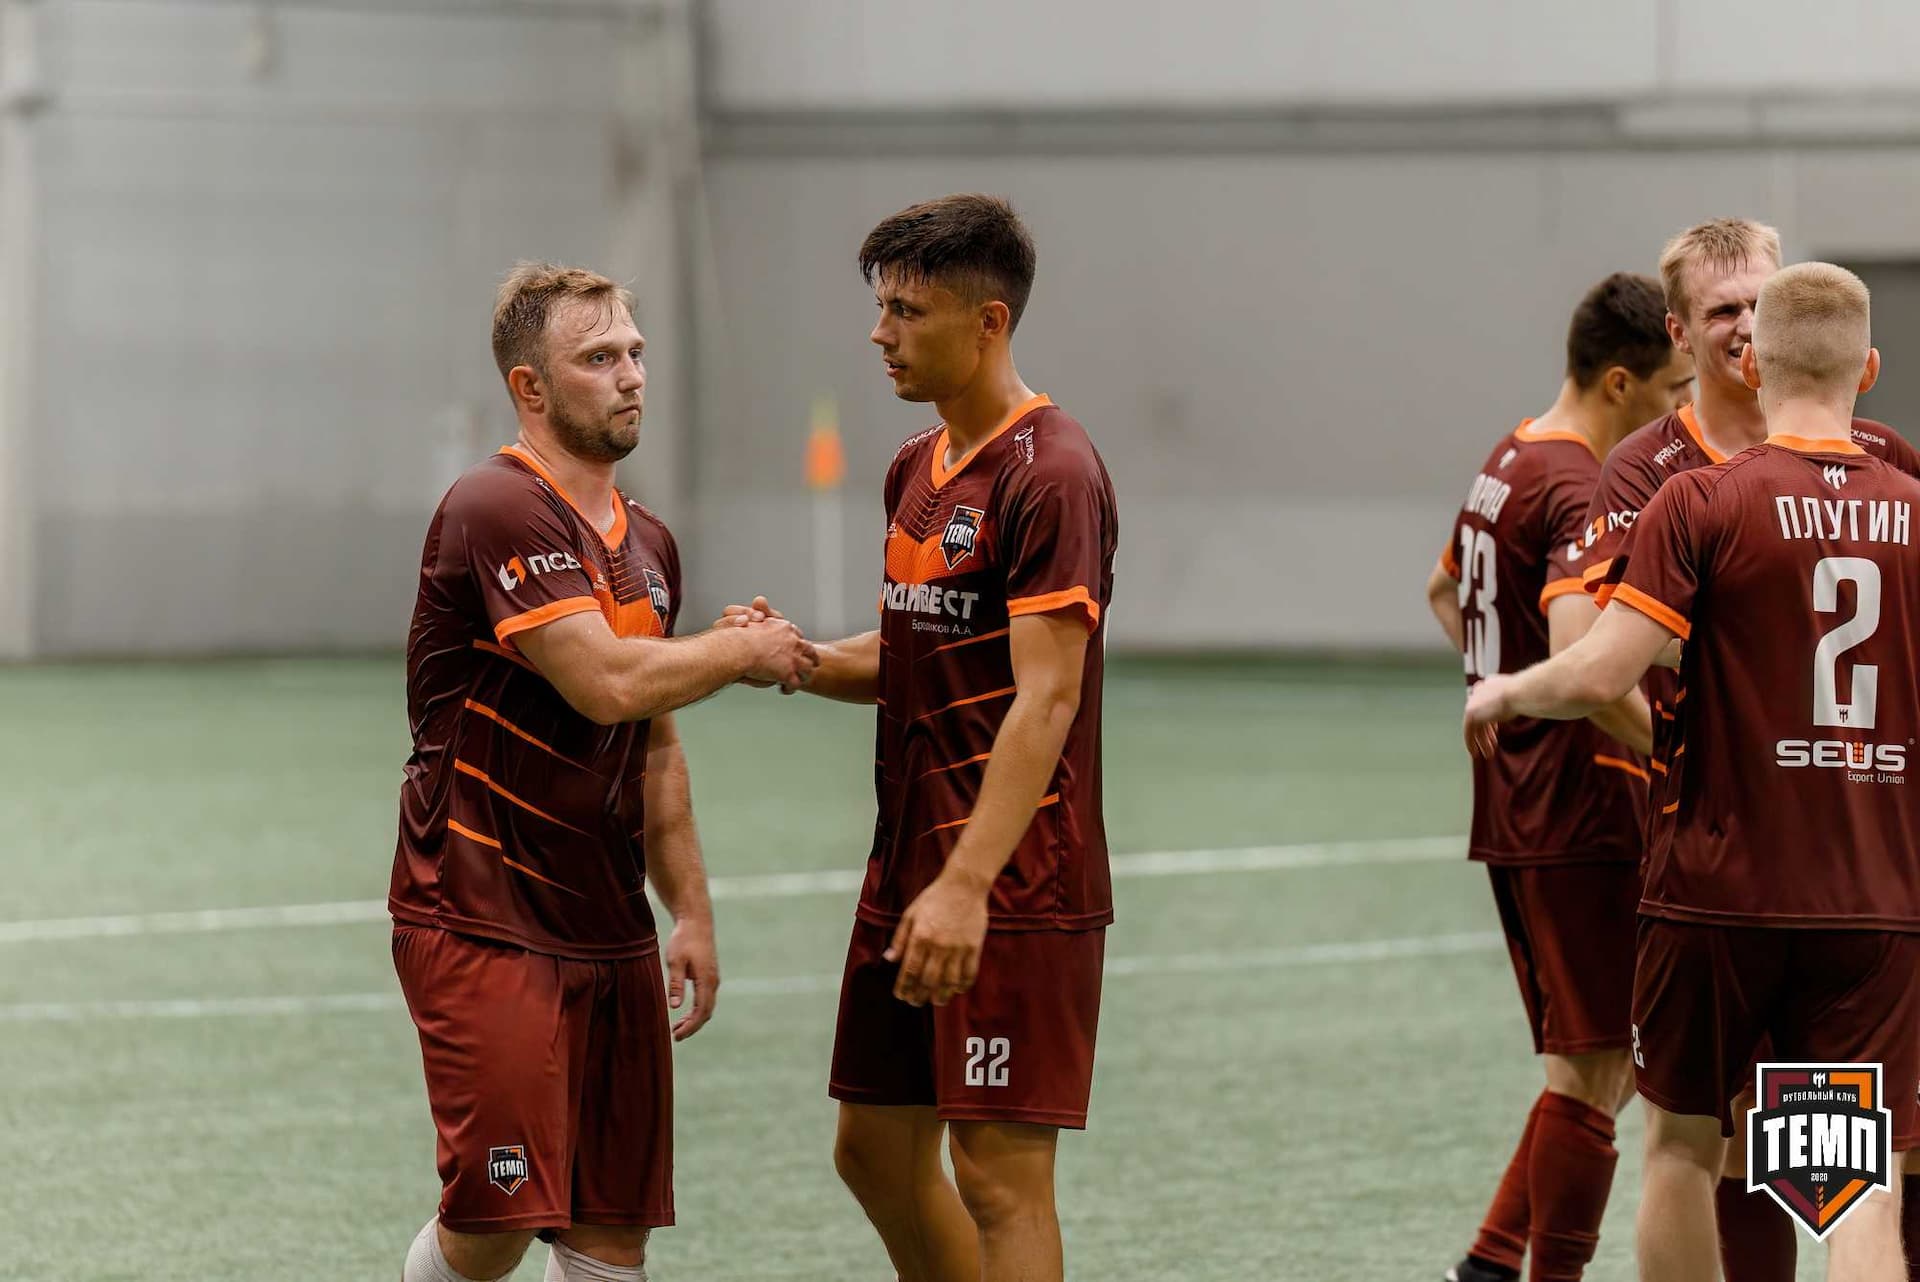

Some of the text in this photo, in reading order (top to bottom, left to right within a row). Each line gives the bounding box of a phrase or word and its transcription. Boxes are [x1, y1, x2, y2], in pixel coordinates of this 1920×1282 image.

[944, 523, 975, 549] ТЕМП
[1775, 496, 1911, 546] ПЛУГИН
[1812, 556, 1882, 730] 2
[1775, 739, 1906, 772] SEUS
[1847, 770, 1905, 785] Export Union
[965, 1036, 1010, 1087] 22
[492, 1159, 525, 1179] ТЕМП
